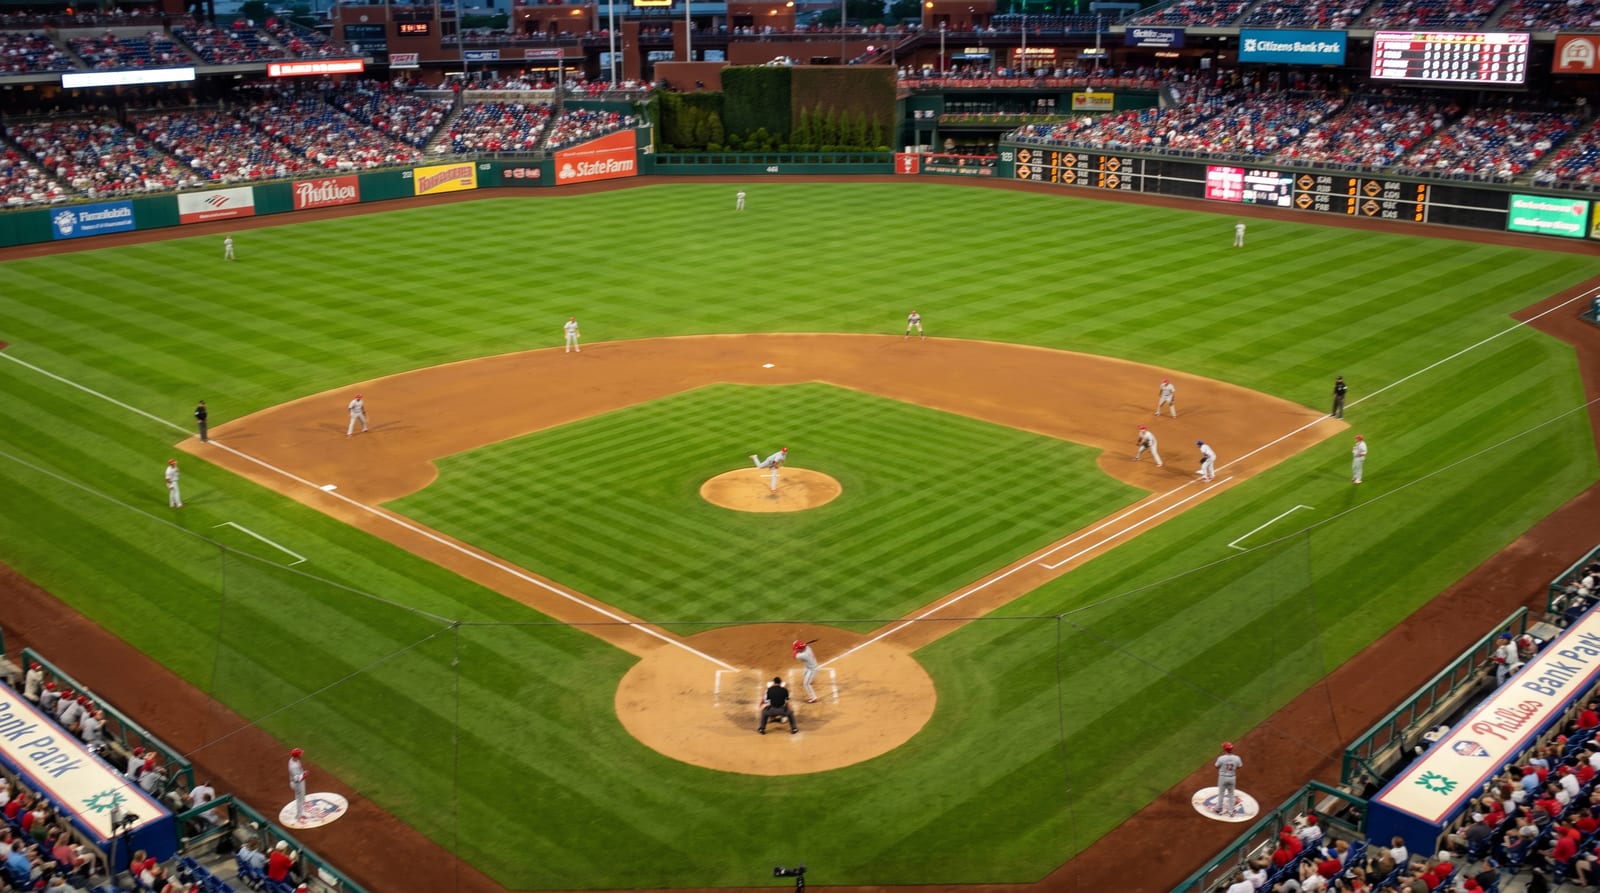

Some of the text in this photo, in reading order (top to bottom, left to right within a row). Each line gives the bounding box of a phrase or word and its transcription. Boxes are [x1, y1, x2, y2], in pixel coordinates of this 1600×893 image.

[1257, 41, 1341, 53] Citizens Bank Park
[1471, 632, 1600, 741] Phillies Bank Park
